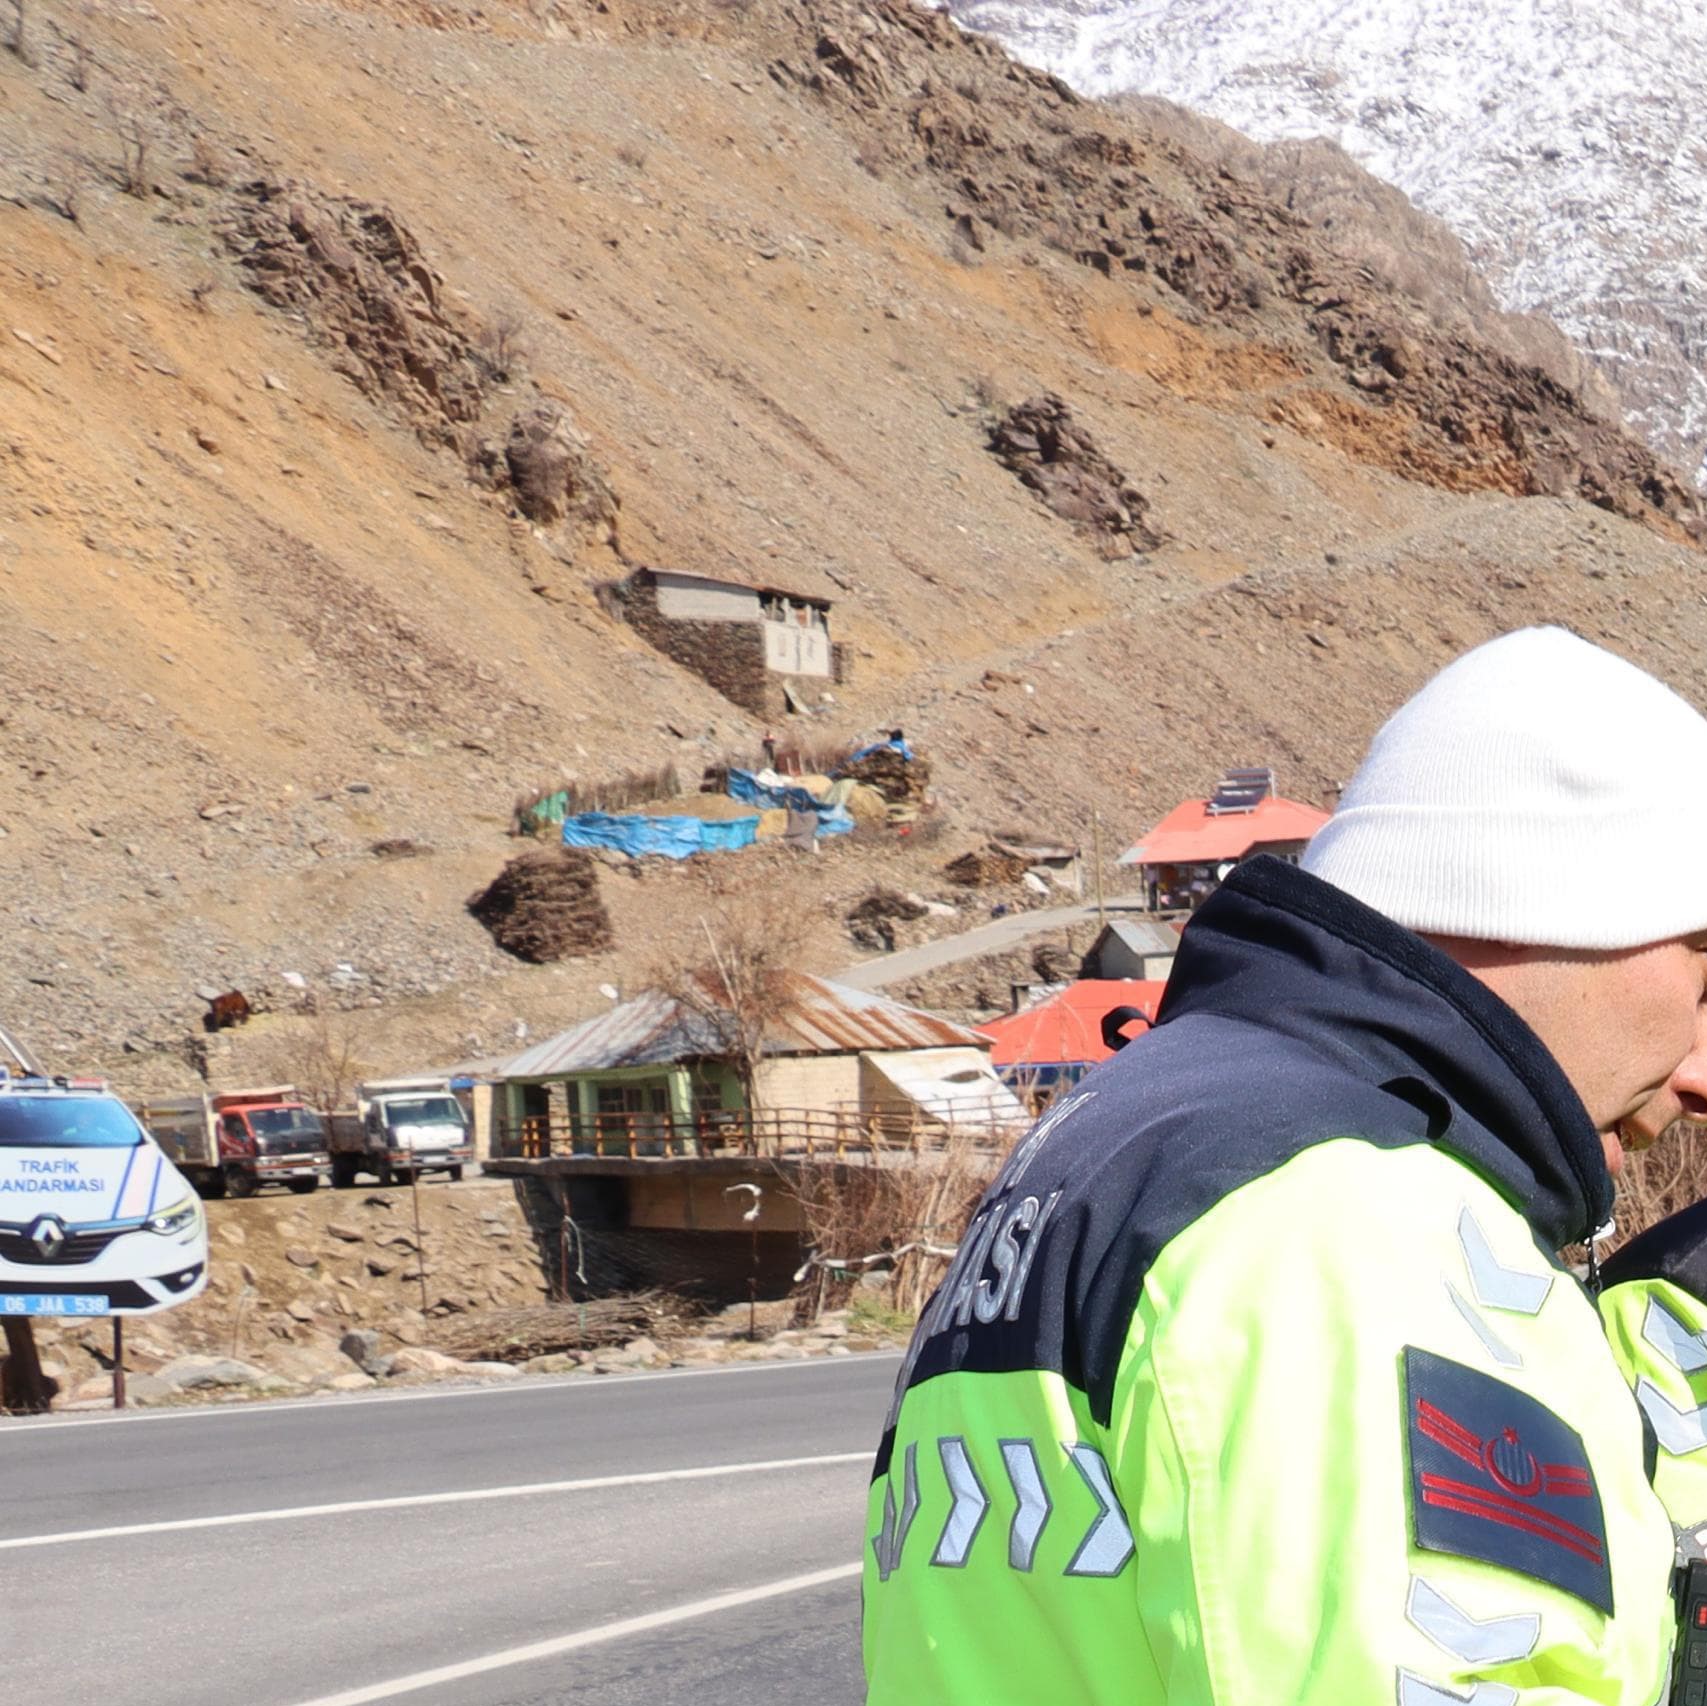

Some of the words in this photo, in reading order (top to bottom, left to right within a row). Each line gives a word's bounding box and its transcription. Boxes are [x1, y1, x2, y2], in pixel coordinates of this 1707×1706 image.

[19, 1158, 79, 1173] TRAFİK
[0, 1179, 105, 1192] ANDARMASI
[5, 1296, 26, 1312] 06
[36, 1296, 64, 1312] JAA
